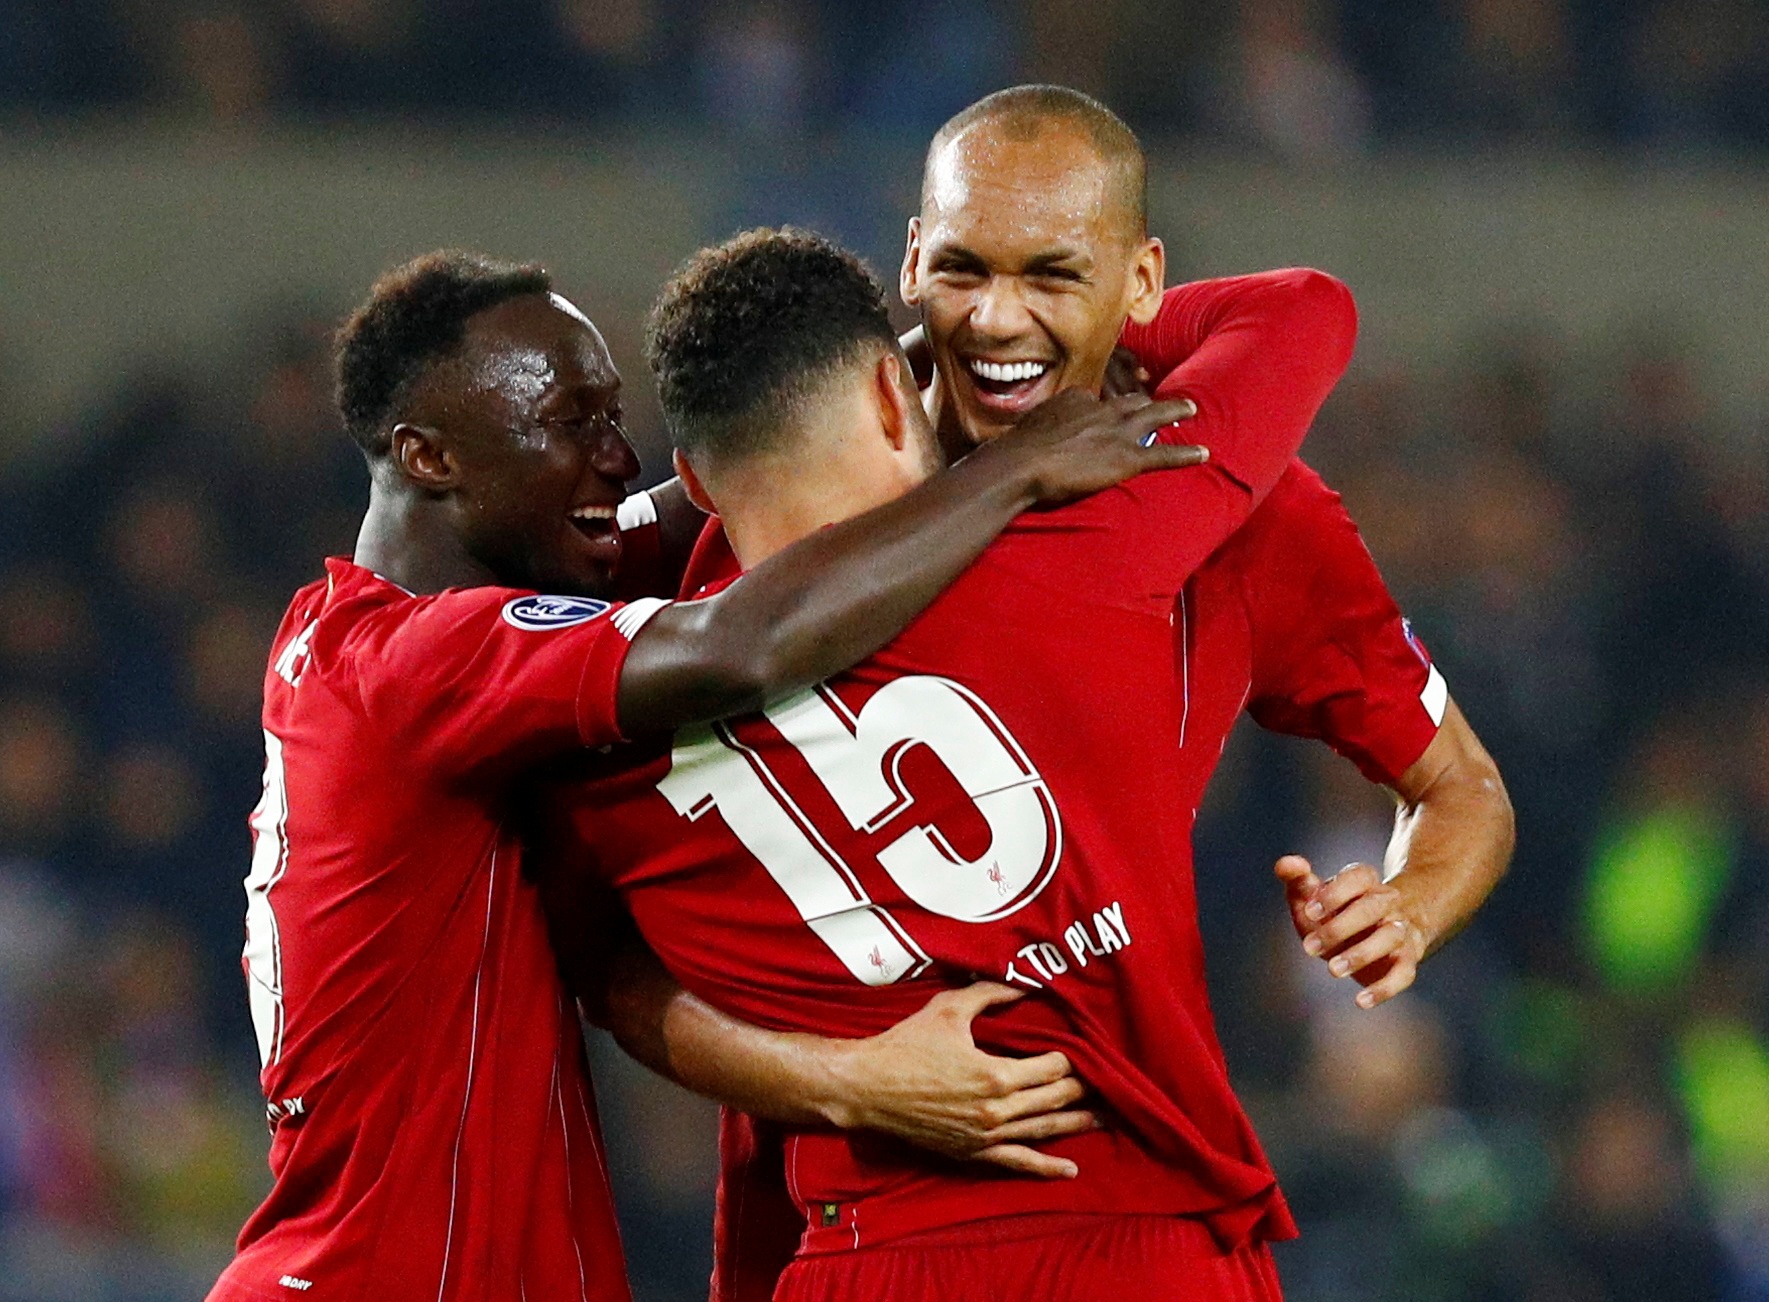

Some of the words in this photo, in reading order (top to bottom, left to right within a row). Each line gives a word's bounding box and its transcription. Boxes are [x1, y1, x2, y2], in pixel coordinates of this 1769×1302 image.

[656, 675, 1064, 987] 15
[1016, 942, 1068, 981] TO
[1064, 901, 1132, 967] PLAY
